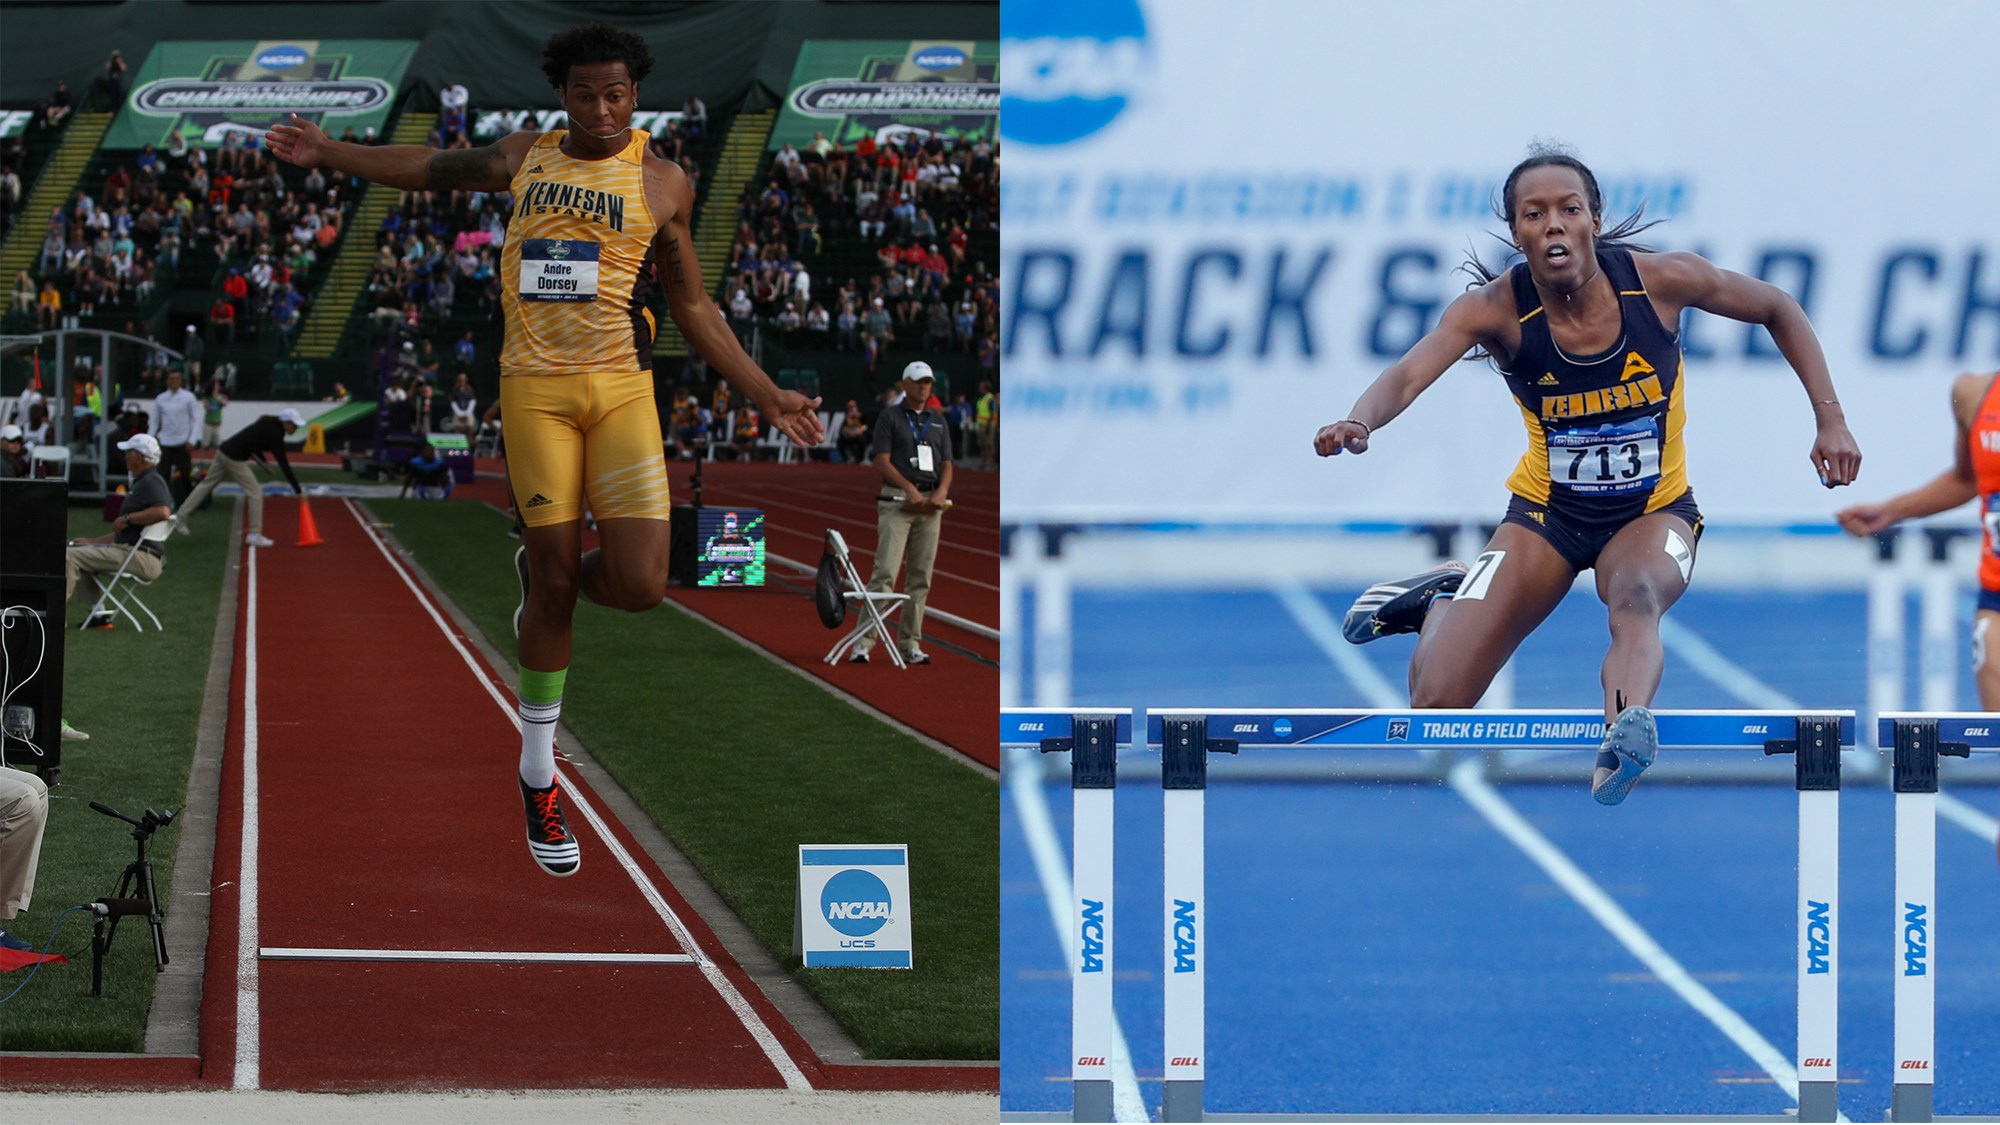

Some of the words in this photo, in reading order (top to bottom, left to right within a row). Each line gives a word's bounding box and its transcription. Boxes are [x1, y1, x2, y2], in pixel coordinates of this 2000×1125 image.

[155, 91, 370, 108] CHAMPIONSHIPS
[519, 182, 624, 233] KENNESAW
[535, 205, 604, 224] STATE
[543, 263, 572, 275] Andre
[538, 277, 578, 292] Dorsey
[1541, 374, 1667, 422] KENNESAW
[1566, 443, 1642, 481] 713
[1018, 722, 1045, 731] GILL
[1233, 724, 1259, 733] GILL
[1423, 723, 1471, 739] TRACK
[1473, 723, 1484, 739] &
[1486, 723, 1527, 739] FIELD
[1742, 725, 1768, 734] GILL
[1963, 727, 1990, 736] GILL
[828, 902, 890, 920] NCAA
[1081, 898, 1104, 974] NCAA
[1173, 898, 1196, 974] NCAA
[1807, 899, 1830, 975] NCAA
[1904, 901, 1927, 977] NCAA
[839, 940, 876, 948] UCS
[1077, 1056, 1106, 1066] GILL
[1170, 1056, 1199, 1066] GILL
[1803, 1058, 1832, 1067] GILL
[1900, 1060, 1929, 1070] GILL
